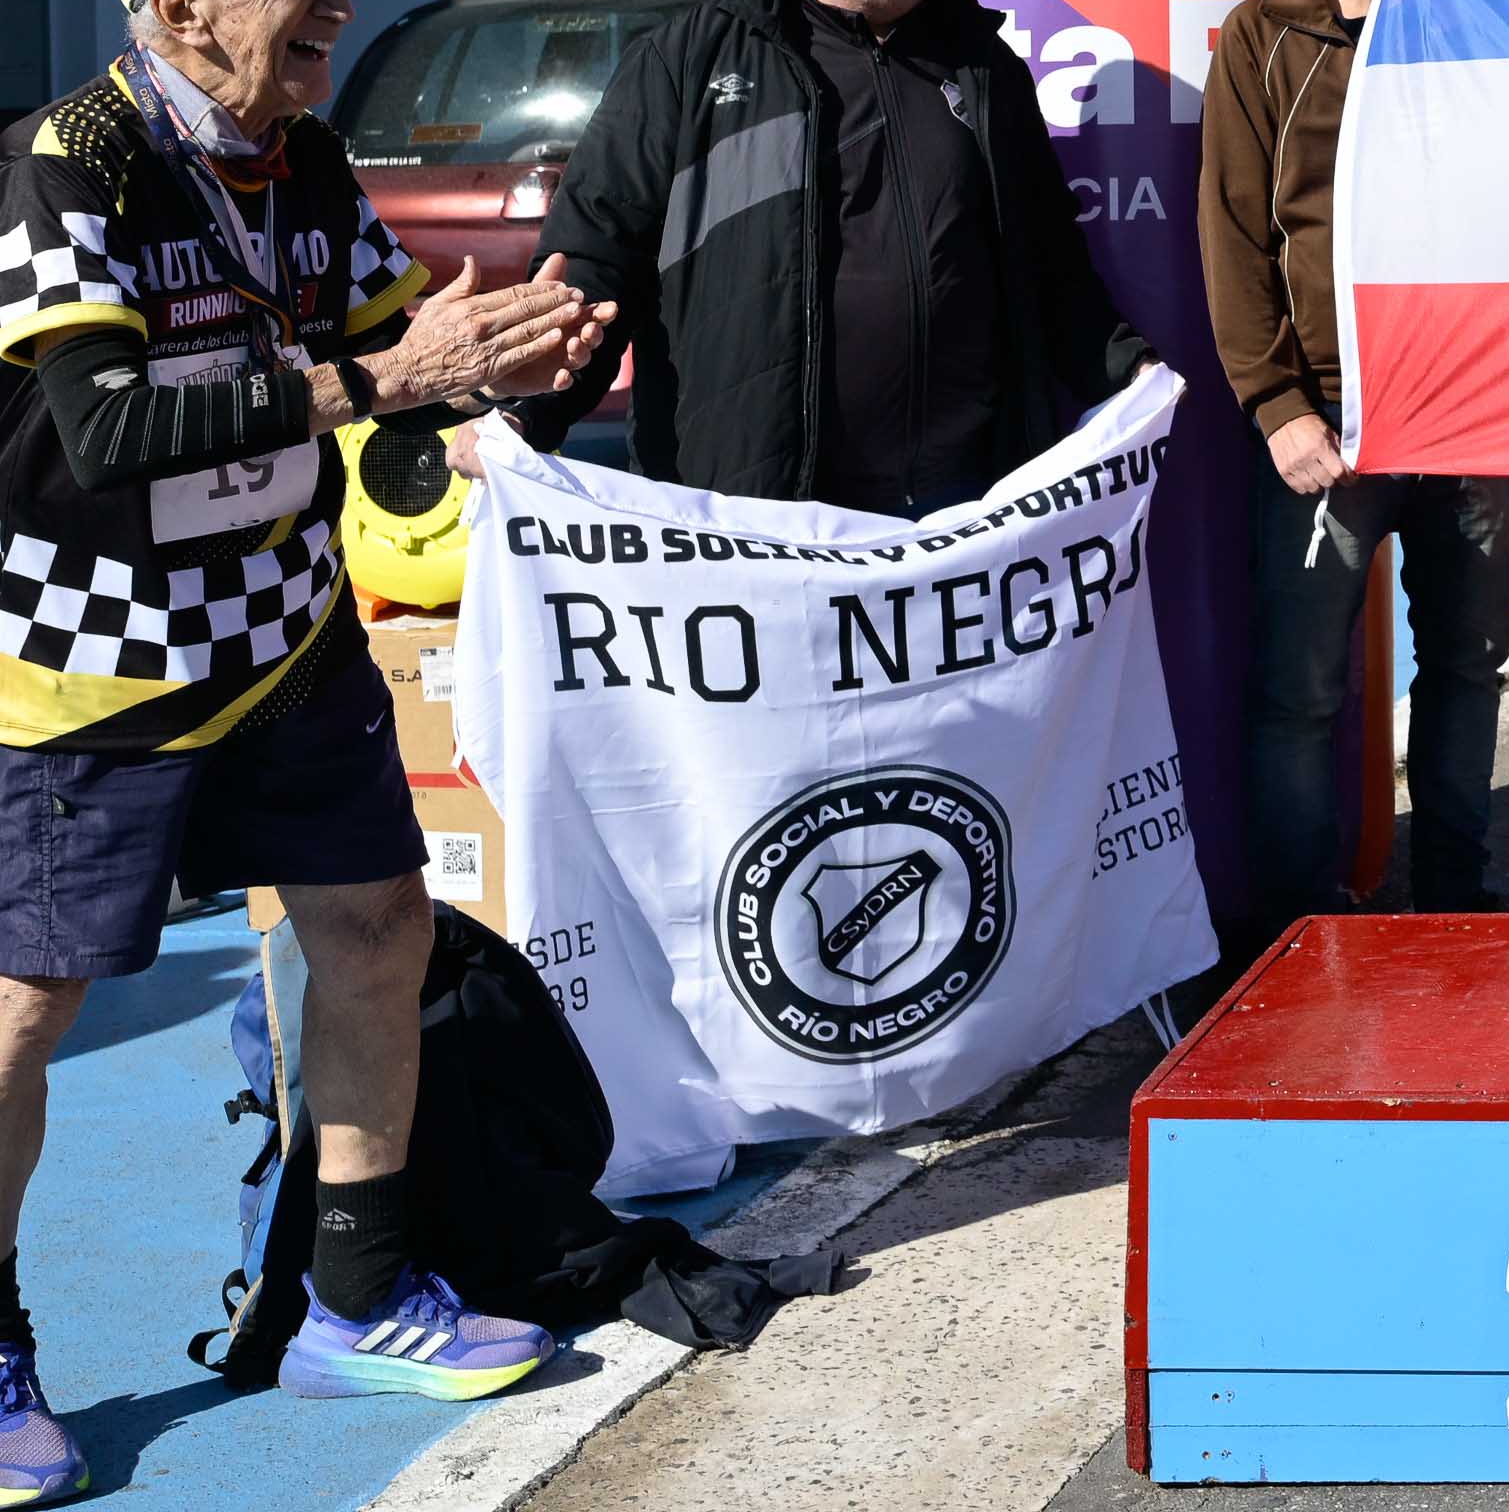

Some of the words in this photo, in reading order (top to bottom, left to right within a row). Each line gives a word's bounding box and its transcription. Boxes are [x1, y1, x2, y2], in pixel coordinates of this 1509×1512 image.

[506, 516, 649, 564] CLUB
[661, 528, 869, 566] SOCIAL
[870, 546, 906, 563] Y
[543, 592, 761, 703] RIO
[745, 797, 864, 888] SOCIAL
[874, 789, 900, 811] Y
[827, 865, 923, 953] CSyDRN
[908, 789, 996, 943] DEPORTIVO
[738, 892, 772, 987] CLUB
[850, 970, 969, 1043] NEGRO
